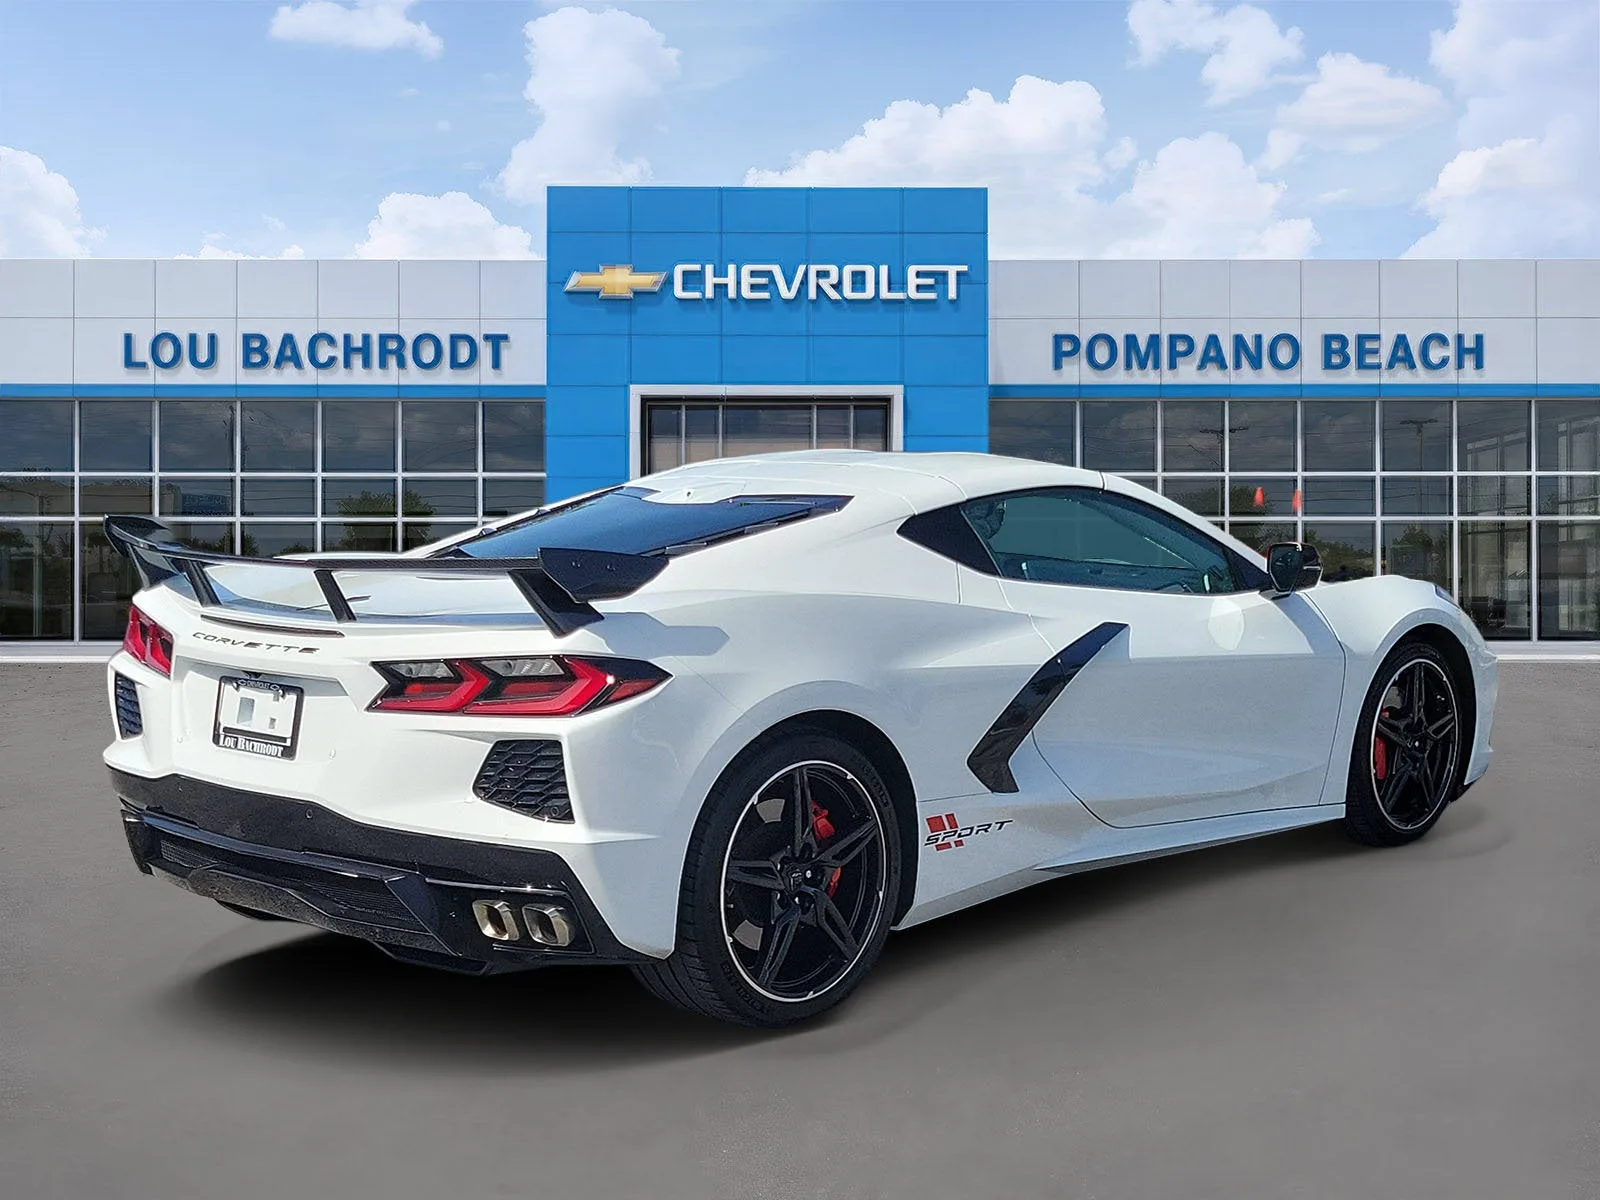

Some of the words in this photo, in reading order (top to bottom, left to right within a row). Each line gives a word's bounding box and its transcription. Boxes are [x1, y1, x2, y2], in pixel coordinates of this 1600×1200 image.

[672, 263, 969, 301] CHEVROLET
[122, 331, 218, 370] LOU
[241, 331, 510, 371] BACHRODT
[1052, 332, 1301, 371] POMPANO
[1320, 332, 1485, 371] BEACH
[192, 631, 321, 655] CORVETTE
[923, 819, 1015, 847] SPORT
